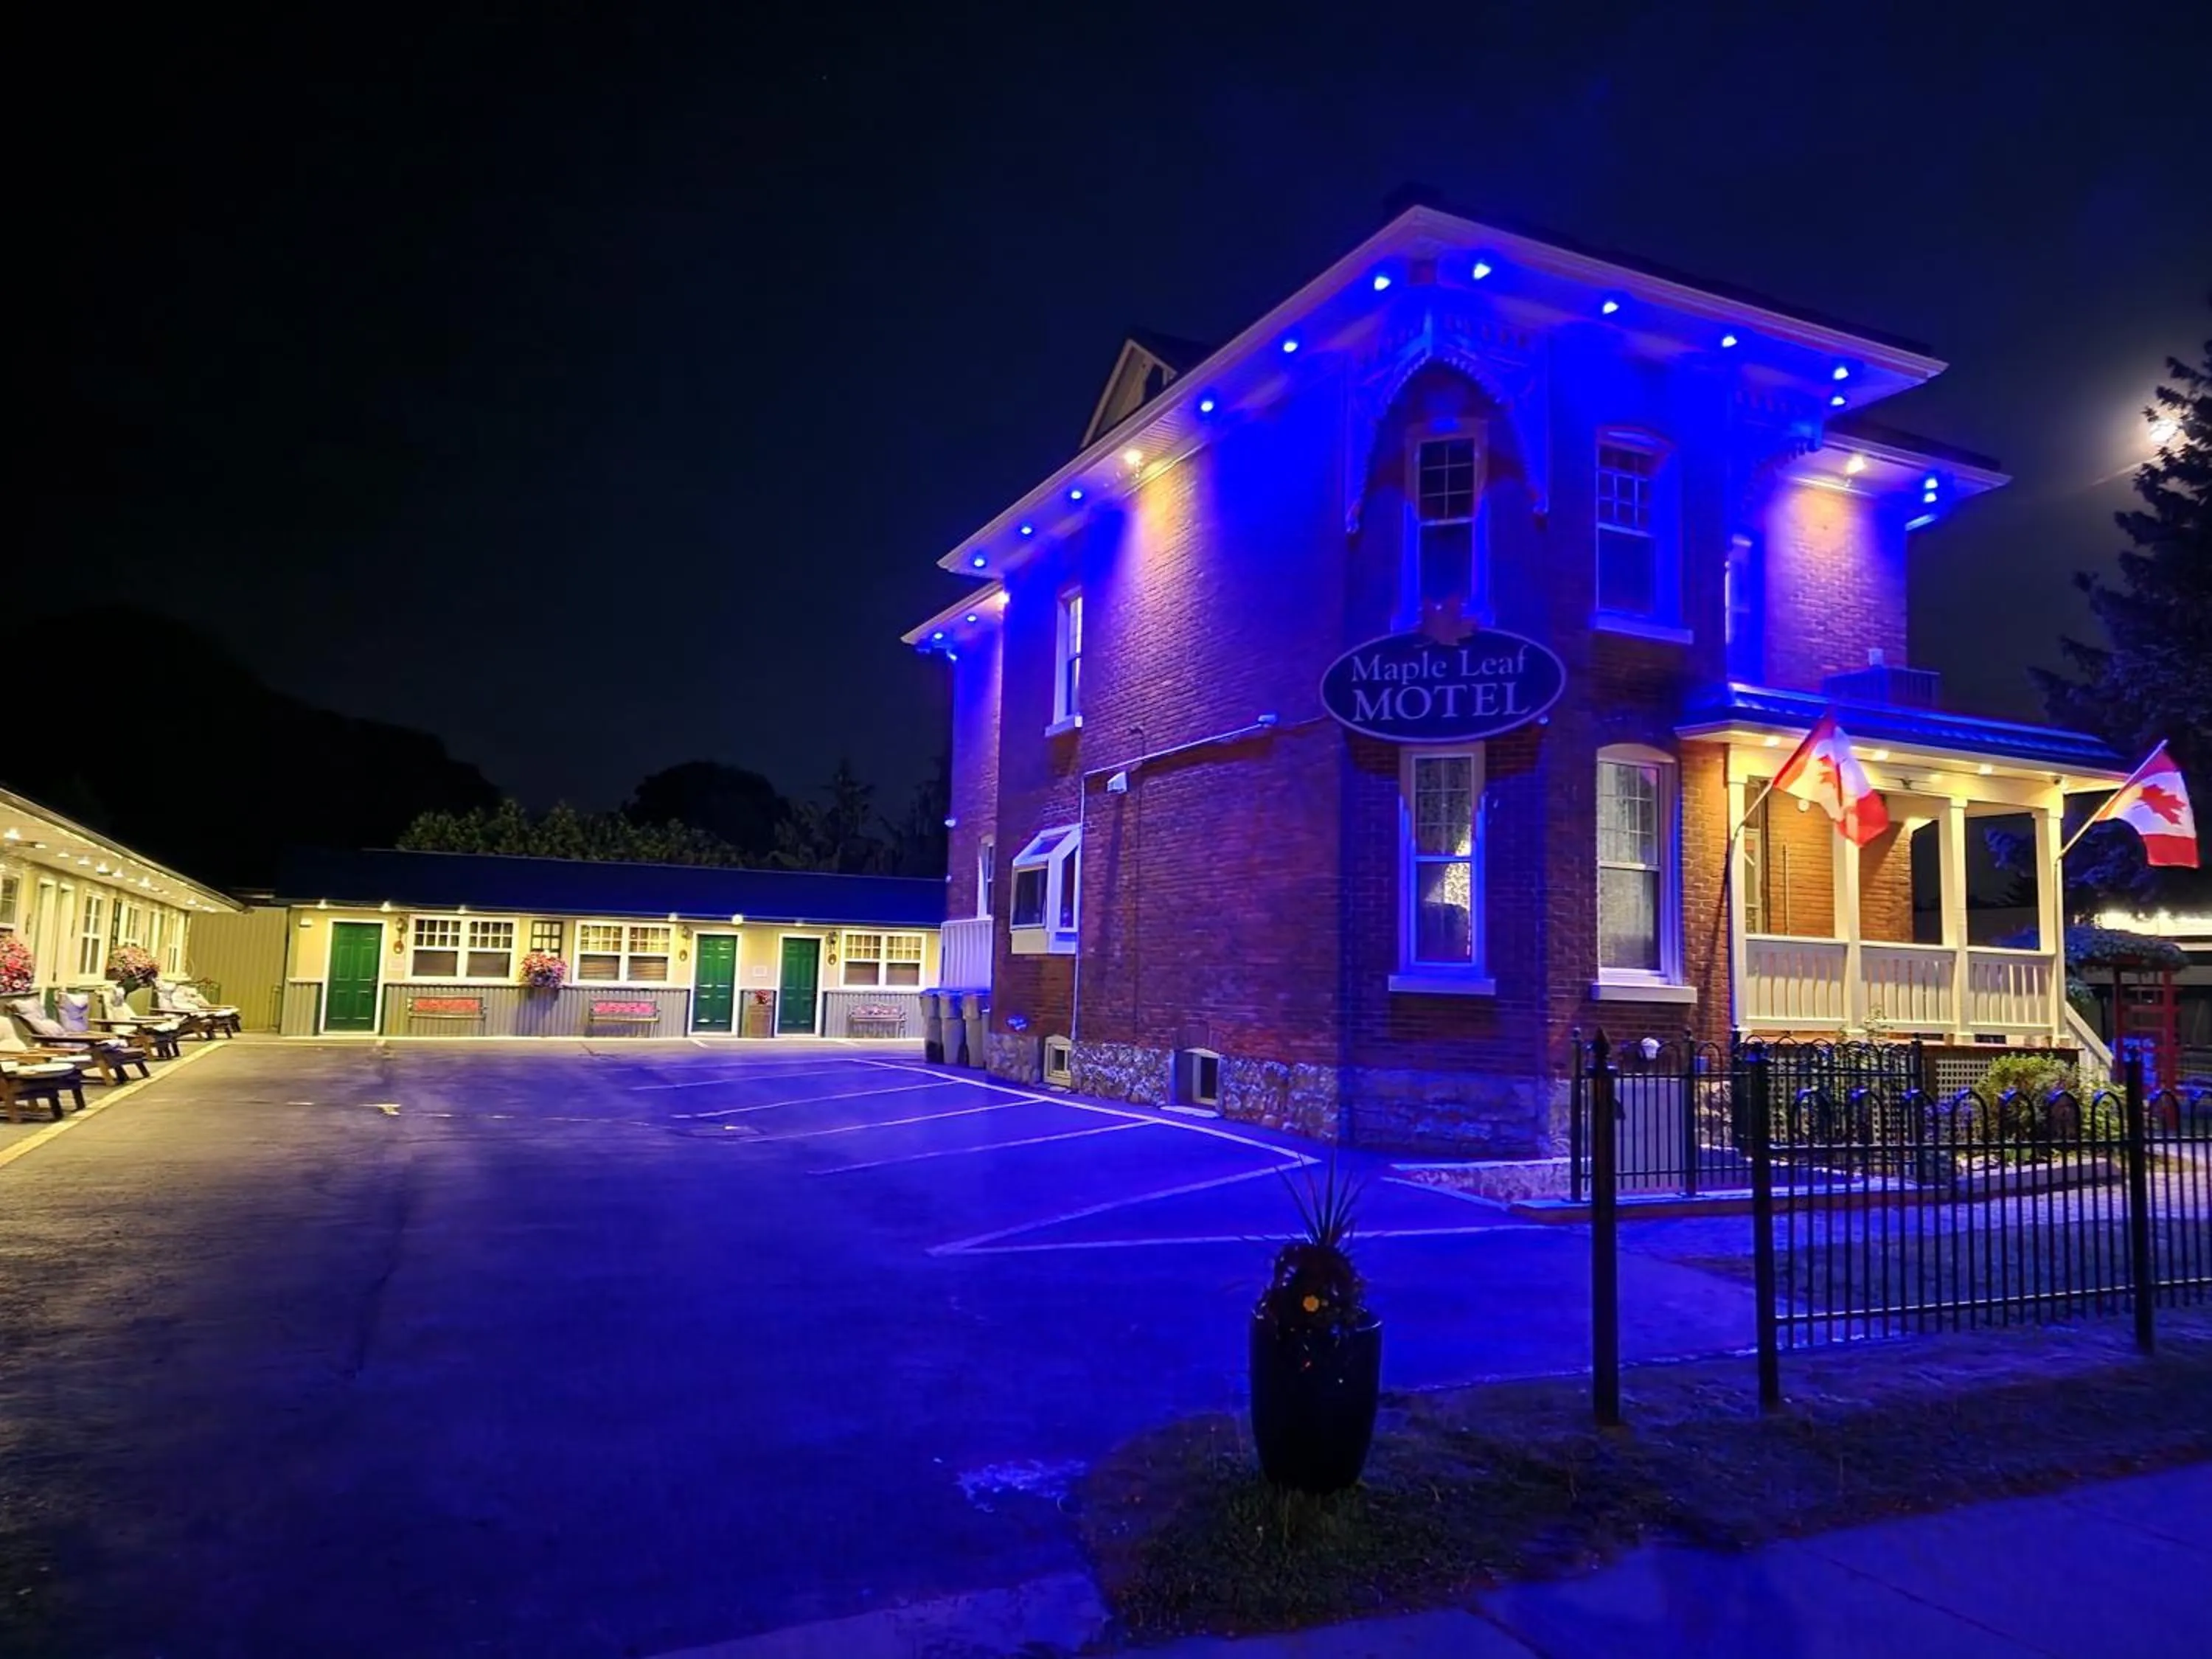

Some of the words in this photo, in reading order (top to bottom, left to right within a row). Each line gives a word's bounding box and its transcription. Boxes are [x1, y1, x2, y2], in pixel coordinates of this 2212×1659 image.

[1352, 651, 1447, 684] Maple
[1459, 645, 1528, 675] Leaf
[1352, 682, 1531, 722] MOTEL
